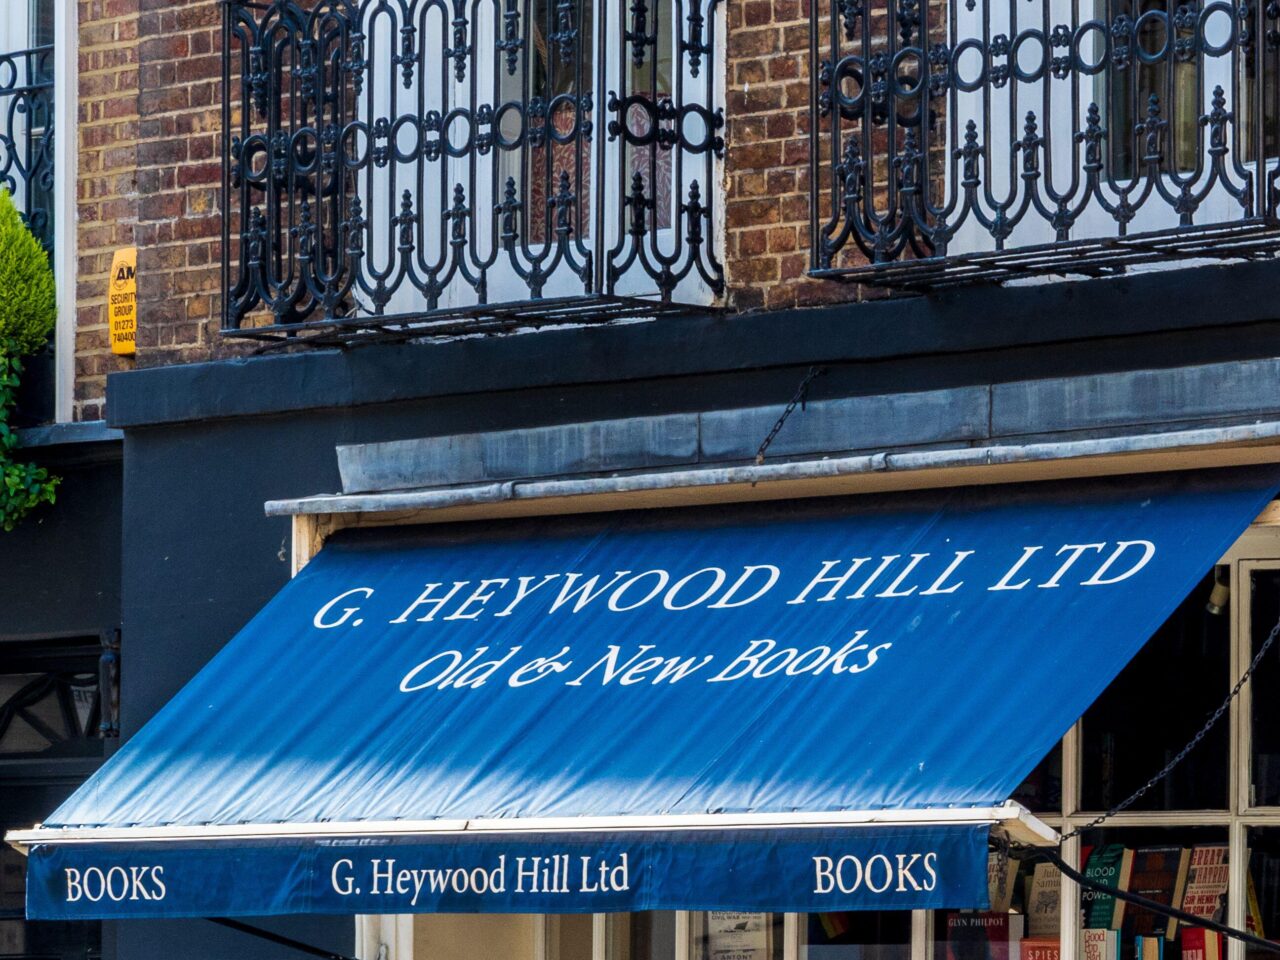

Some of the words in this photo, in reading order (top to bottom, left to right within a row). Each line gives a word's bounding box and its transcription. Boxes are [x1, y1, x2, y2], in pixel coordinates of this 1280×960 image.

[111, 292, 137, 305] SECURITY
[114, 305, 133, 317] GROUP
[114, 320, 134, 331] 01273
[113, 331, 136, 343] 740400
[313, 587, 374, 629] G.
[390, 564, 780, 624] HEYWOOD
[787, 550, 975, 604] HILL
[987, 540, 1156, 591] LTD
[399, 645, 523, 692] Old
[508, 646, 573, 687] &
[565, 644, 714, 686] New
[707, 629, 893, 683] Books
[65, 865, 166, 902] BOOKS
[332, 858, 361, 894] G.
[371, 854, 506, 905] Heywood
[515, 854, 570, 892] Hill
[580, 852, 630, 892] Ltd
[812, 852, 937, 893] BOOKS
[1086, 867, 1116, 878] BLOOD
[948, 918, 967, 927] GLYN
[970, 917, 1004, 927] PHILPOT
[1028, 950, 1059, 960] SPIES
